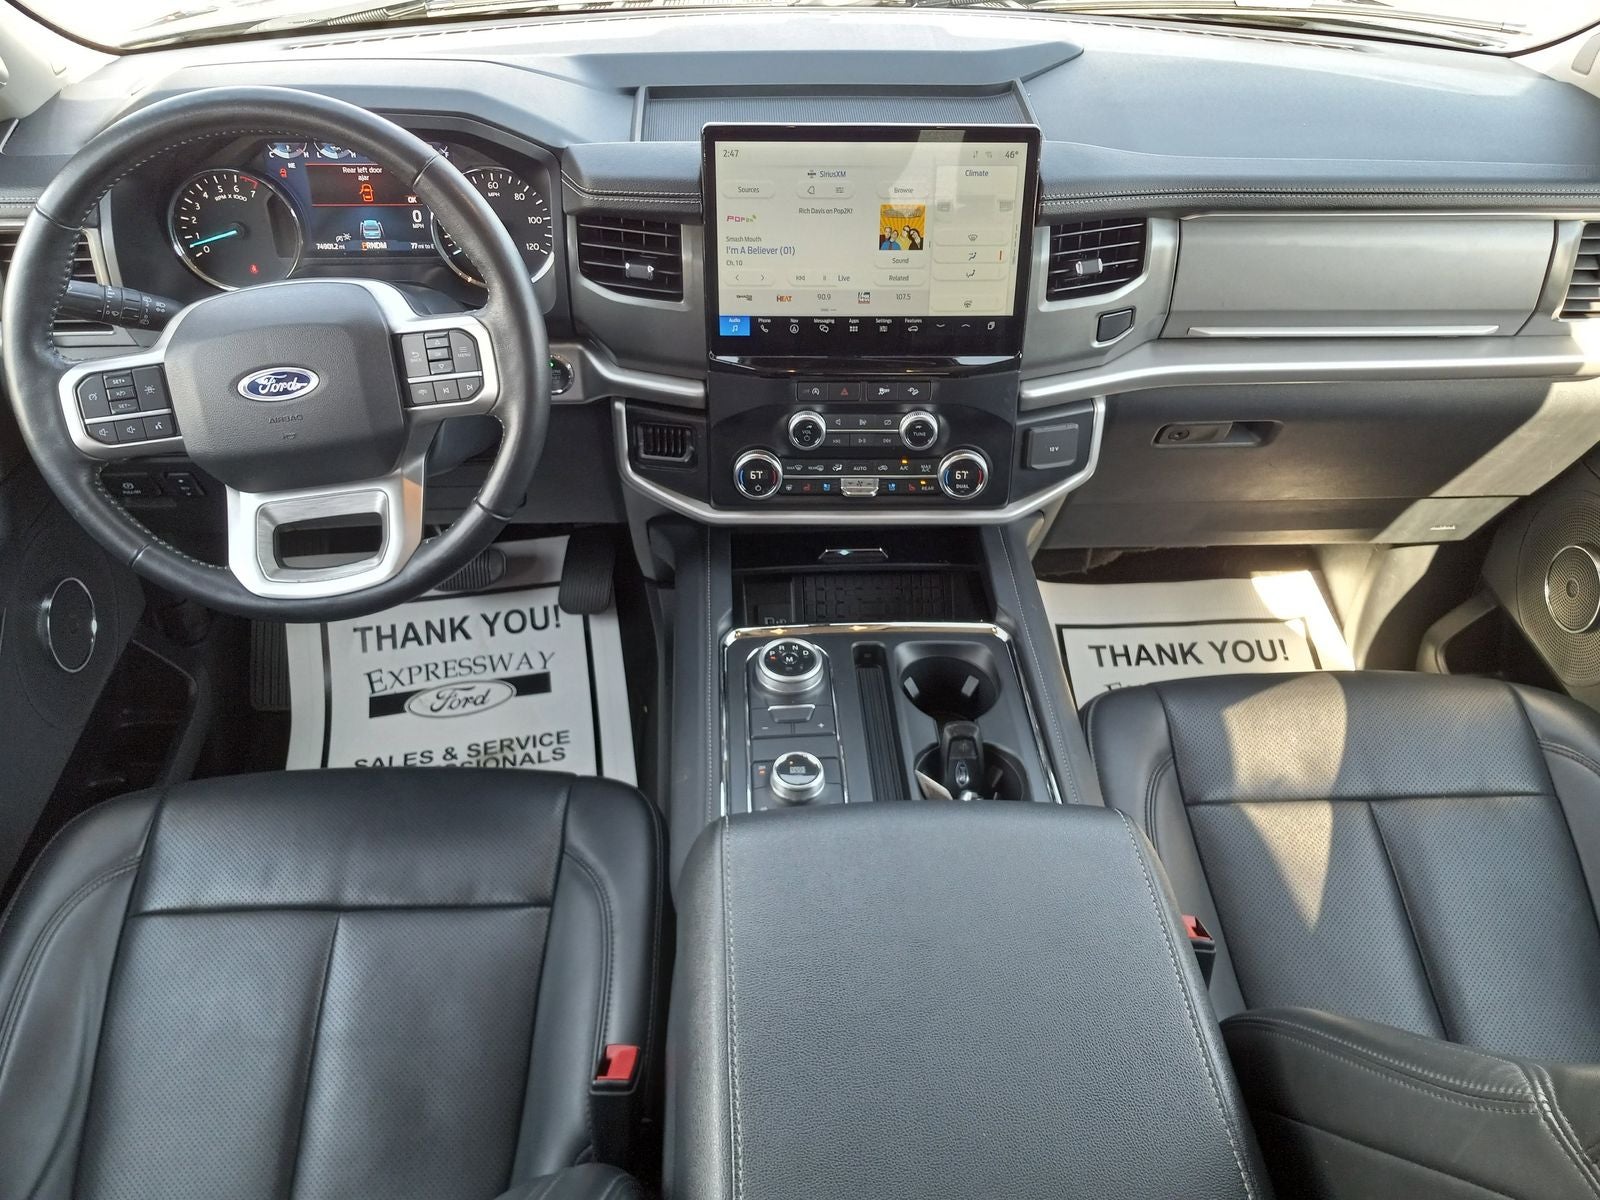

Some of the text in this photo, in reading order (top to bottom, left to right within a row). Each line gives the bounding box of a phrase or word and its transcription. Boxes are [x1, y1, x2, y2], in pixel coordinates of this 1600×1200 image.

[722, 149, 739, 158] 2:47
[342, 166, 383, 174] Rear left door
[819, 170, 847, 178] SiriusXM
[964, 169, 989, 177] Climate
[358, 174, 370, 182] ajar
[217, 185, 224, 193] 5
[233, 185, 240, 193] 6
[487, 181, 499, 190] 60
[250, 190, 256, 198] 7
[737, 186, 760, 194] Sources
[893, 186, 915, 194] Browse
[202, 191, 209, 199] 4
[232, 193, 248, 202] 1000
[514, 192, 525, 201] 80
[407, 196, 418, 204] OK
[194, 202, 201, 210] 3
[798, 206, 811, 215] Rich
[811, 206, 826, 215] Davis
[191, 216, 198, 224] 2
[411, 209, 423, 223] 0
[527, 215, 542, 225] 100
[195, 232, 200, 240] 1
[725, 235, 762, 243] Smash Mouth
[203, 245, 211, 253] 0
[525, 242, 540, 251] 120
[726, 245, 796, 256] I'm A Believer (01)
[735, 259, 743, 267] 10
[837, 274, 851, 282] Live
[817, 293, 832, 301] 90.9
[895, 293, 912, 301] 107.5
[268, 414, 304, 424] AIRBAG
[353, 604, 561, 654] THANK YOU!
[1088, 638, 1289, 668] THANK YOU!
[364, 651, 556, 695] EXPRESSWAY
[429, 685, 491, 713] Ford
[442, 746, 458, 762] &
[467, 729, 571, 758] SERVICE
